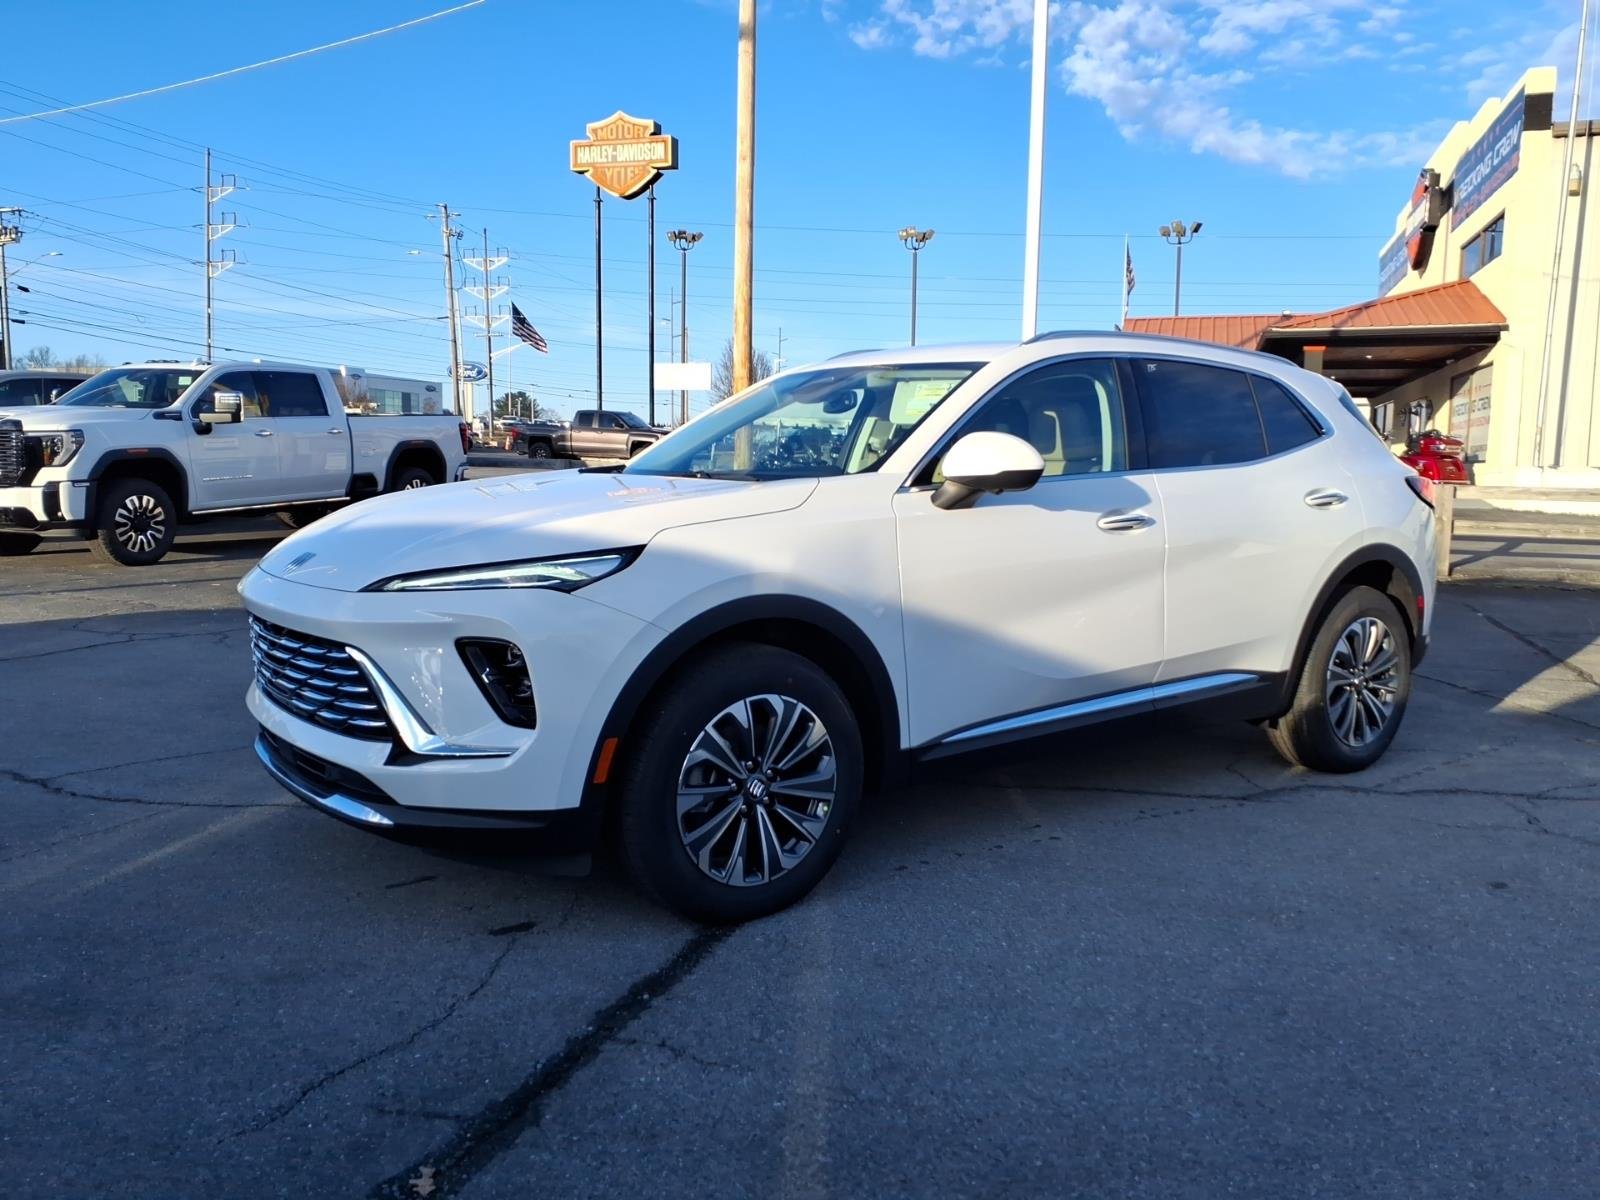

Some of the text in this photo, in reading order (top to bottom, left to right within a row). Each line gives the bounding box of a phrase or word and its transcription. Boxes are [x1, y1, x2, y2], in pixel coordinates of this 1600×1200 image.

[596, 120, 643, 141] MOTOR
[1493, 119, 1521, 164] CREW
[577, 142, 665, 164] HARLEY-DAVIDSON
